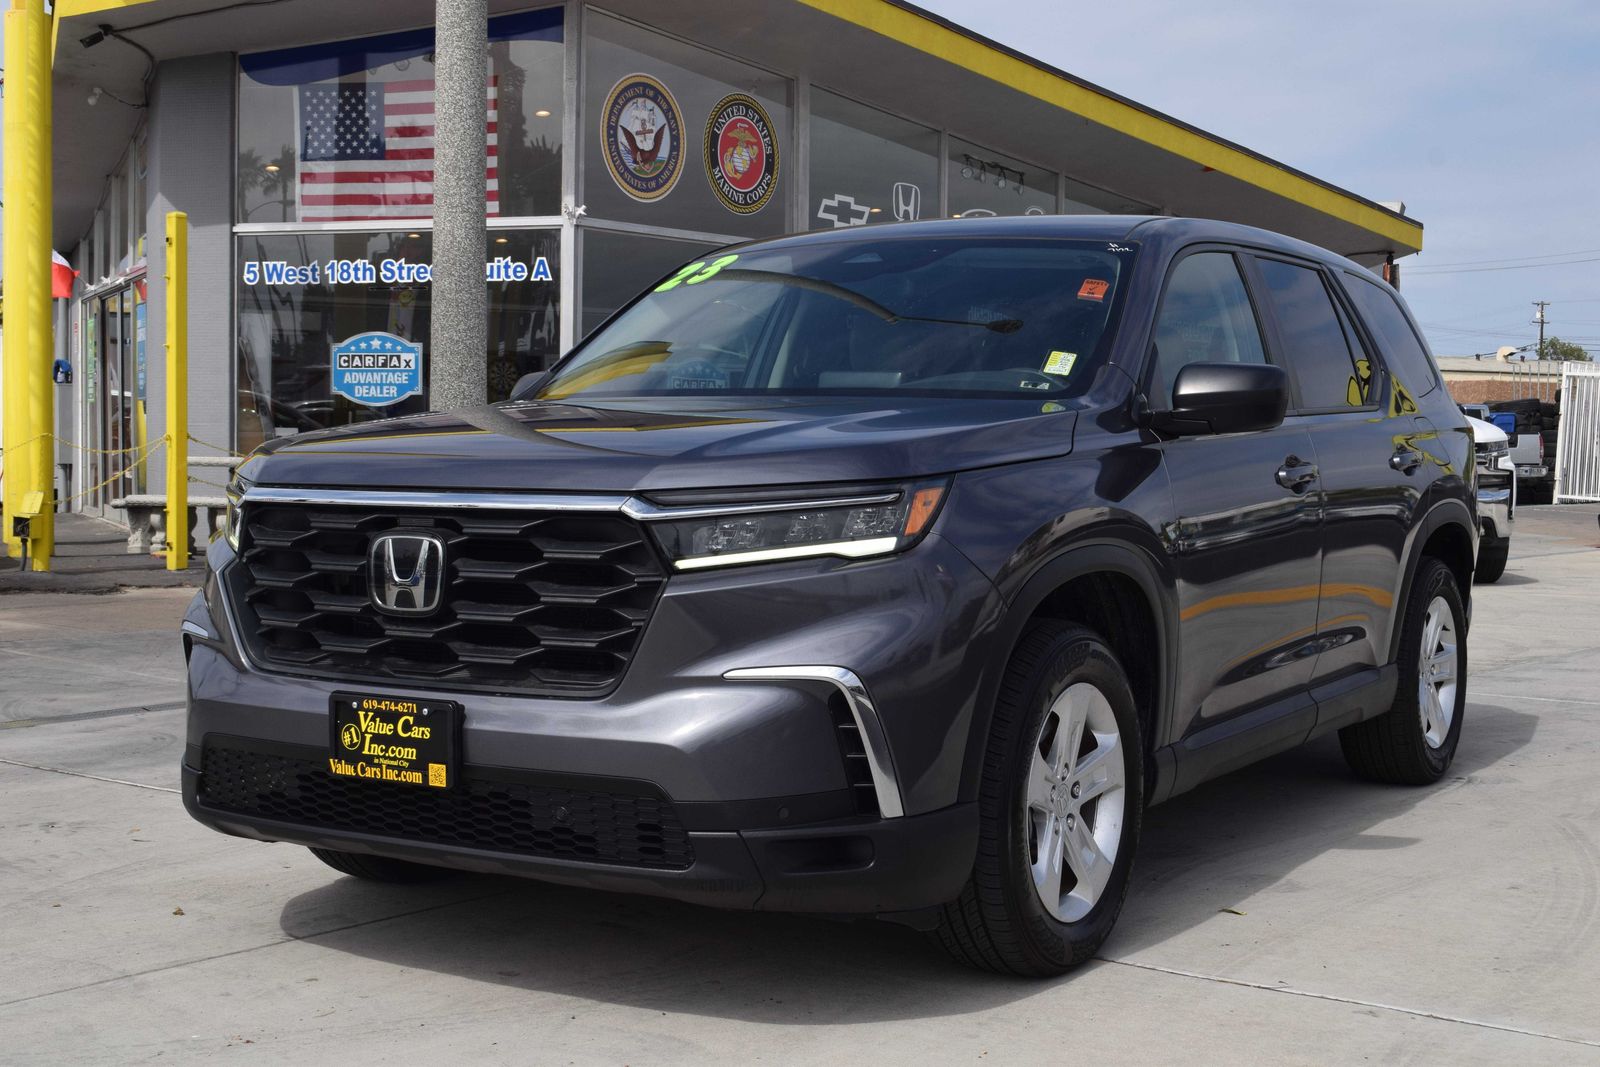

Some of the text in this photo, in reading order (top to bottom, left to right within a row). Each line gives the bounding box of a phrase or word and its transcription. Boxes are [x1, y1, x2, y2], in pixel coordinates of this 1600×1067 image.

[610, 86, 679, 136] DEPARTMENT OF THE NAVY
[714, 105, 773, 154] UNITED STATES
[608, 137, 678, 189] UNITED STATES OF AMERICA
[713, 166, 772, 203] MARINE CORPS
[244, 256, 552, 285] 5 West 18th Stre uite A
[653, 254, 739, 292] 23
[339, 354, 413, 369] CARFAX
[343, 372, 409, 384] ADVANTAGE
[354, 385, 398, 398] DEALER
[363, 699, 417, 713] 619-474-6271
[358, 711, 431, 739] Value Cars
[362, 734, 417, 760] Inc.com
[380, 758, 399, 767] National
